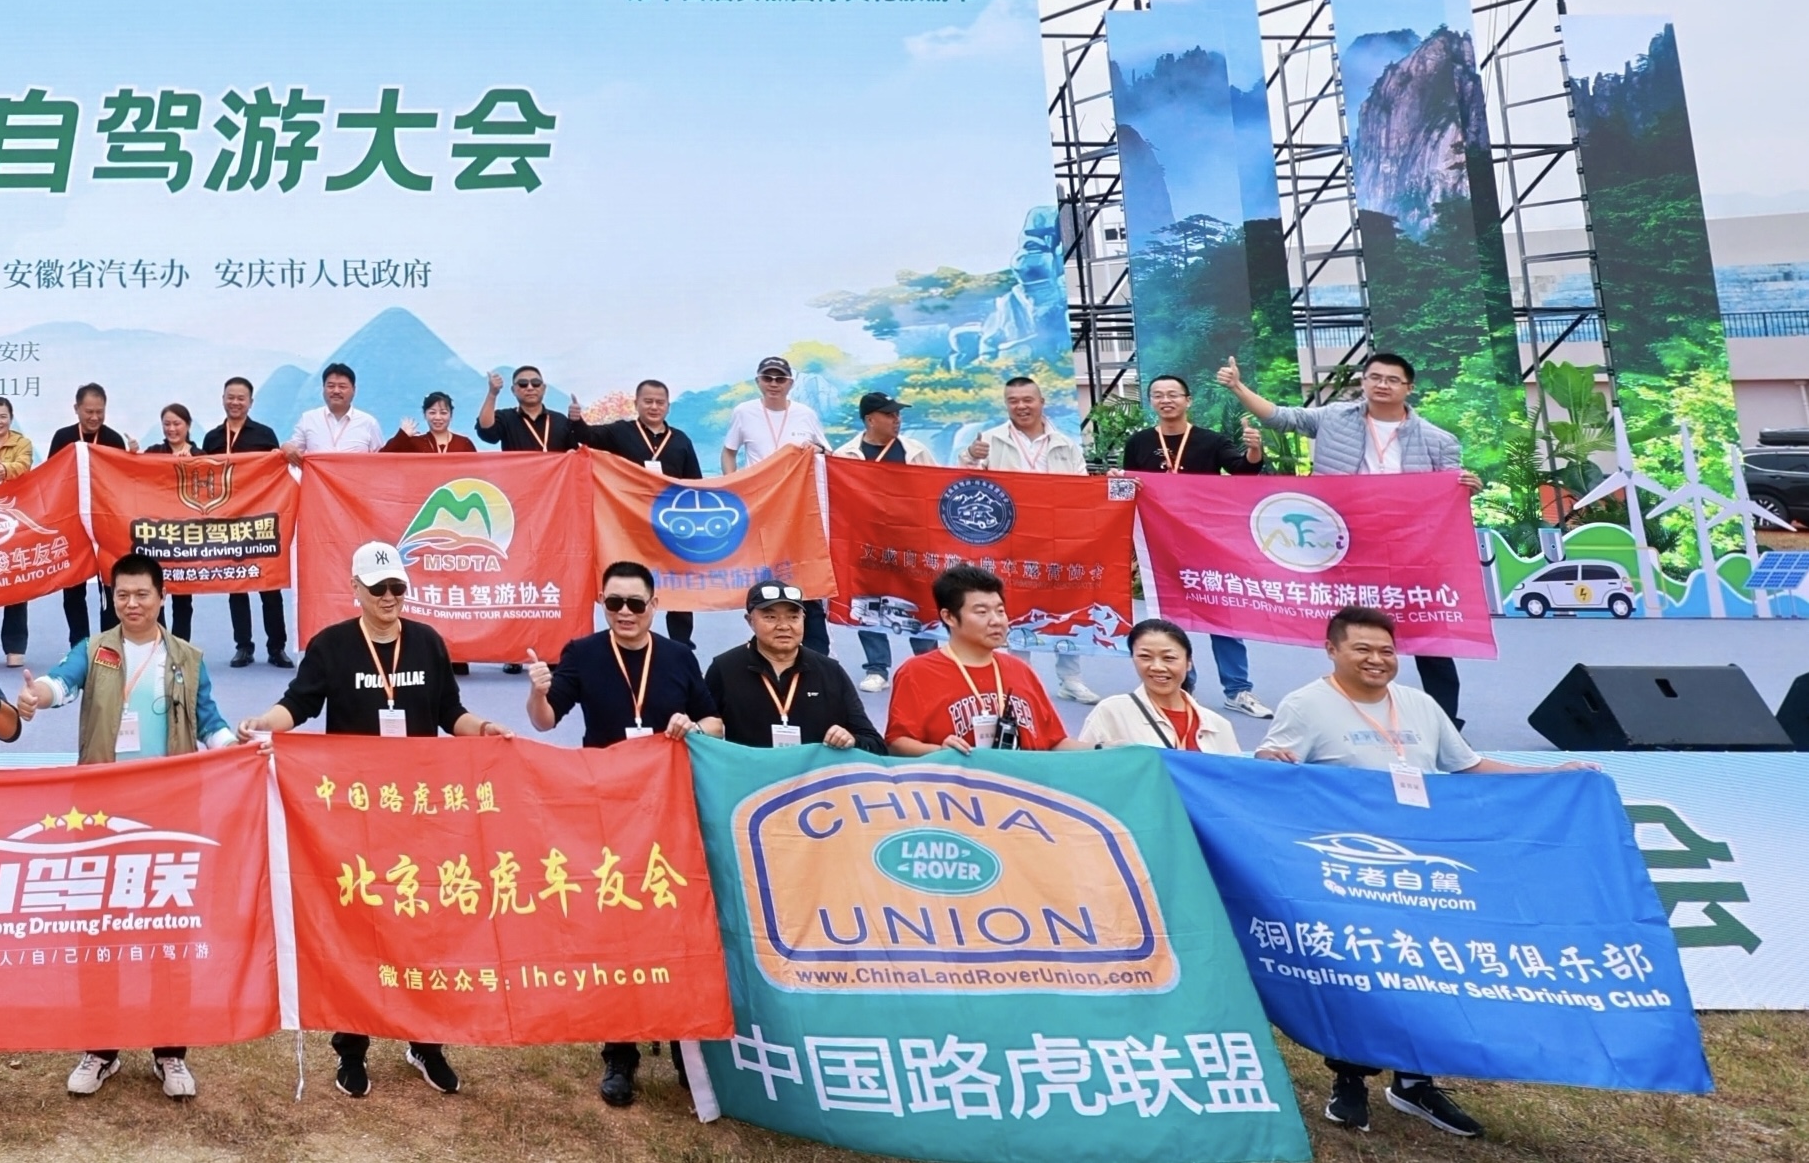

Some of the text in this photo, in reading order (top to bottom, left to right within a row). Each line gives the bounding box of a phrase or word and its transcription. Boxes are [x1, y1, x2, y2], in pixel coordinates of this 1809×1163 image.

[2, 258, 190, 291] 安徽省汽车办
[215, 258, 432, 291] 安庆市人民政府
[135, 517, 276, 545] 中华自驾联盟
[136, 543, 277, 559] China Self driving union
[423, 554, 501, 573] MSDTA
[14, 569, 45, 585] AUTO
[46, 559, 71, 575] CLUB
[162, 564, 261, 581] 安徽总会六安分会
[1179, 568, 1460, 610] 安徽省自驾车旅游服务中心
[410, 606, 433, 616] SELF
[433, 608, 472, 620] DRIVING
[474, 610, 501, 620] TOUR
[502, 609, 562, 620] ASSOCIATION
[1185, 591, 1338, 620] ANHUI SELF-DRIVING TRAVE
[1408, 610, 1464, 623] CENTER
[314, 775, 500, 815] 中国路虎联盟
[797, 790, 1057, 844] CHINA
[901, 840, 959, 861] LAND
[336, 842, 687, 920] 北京路虎车友会
[912, 861, 982, 882] ROVER
[28, 917, 100, 938] Driving
[102, 913, 202, 930] Federation
[818, 905, 1098, 947] UNION
[796, 966, 1154, 987] www.ChinaLandRoverUnion.com
[1258, 956, 1672, 1011] Tongling Walker Self-Driving Club
[731, 1024, 1282, 1121] 中国路虎联盟
